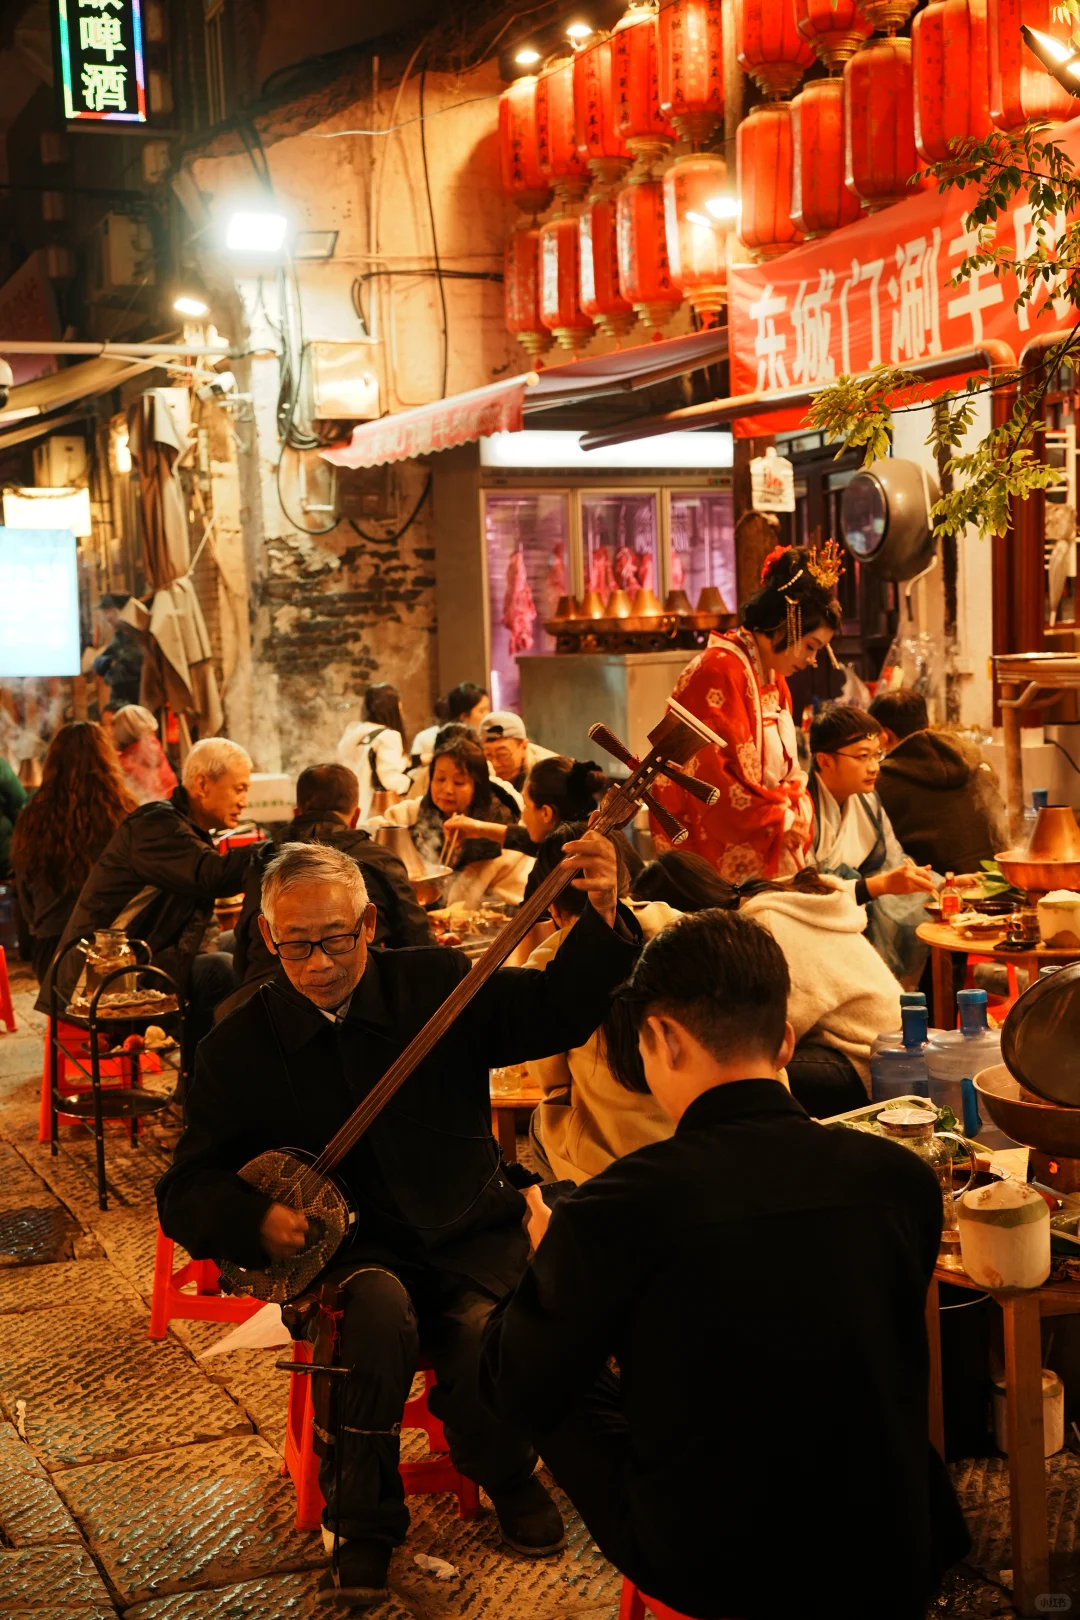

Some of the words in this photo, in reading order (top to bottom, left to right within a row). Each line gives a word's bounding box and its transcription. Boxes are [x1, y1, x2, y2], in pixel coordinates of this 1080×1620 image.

[749, 177, 1071, 394] 东城门涮羊肉
